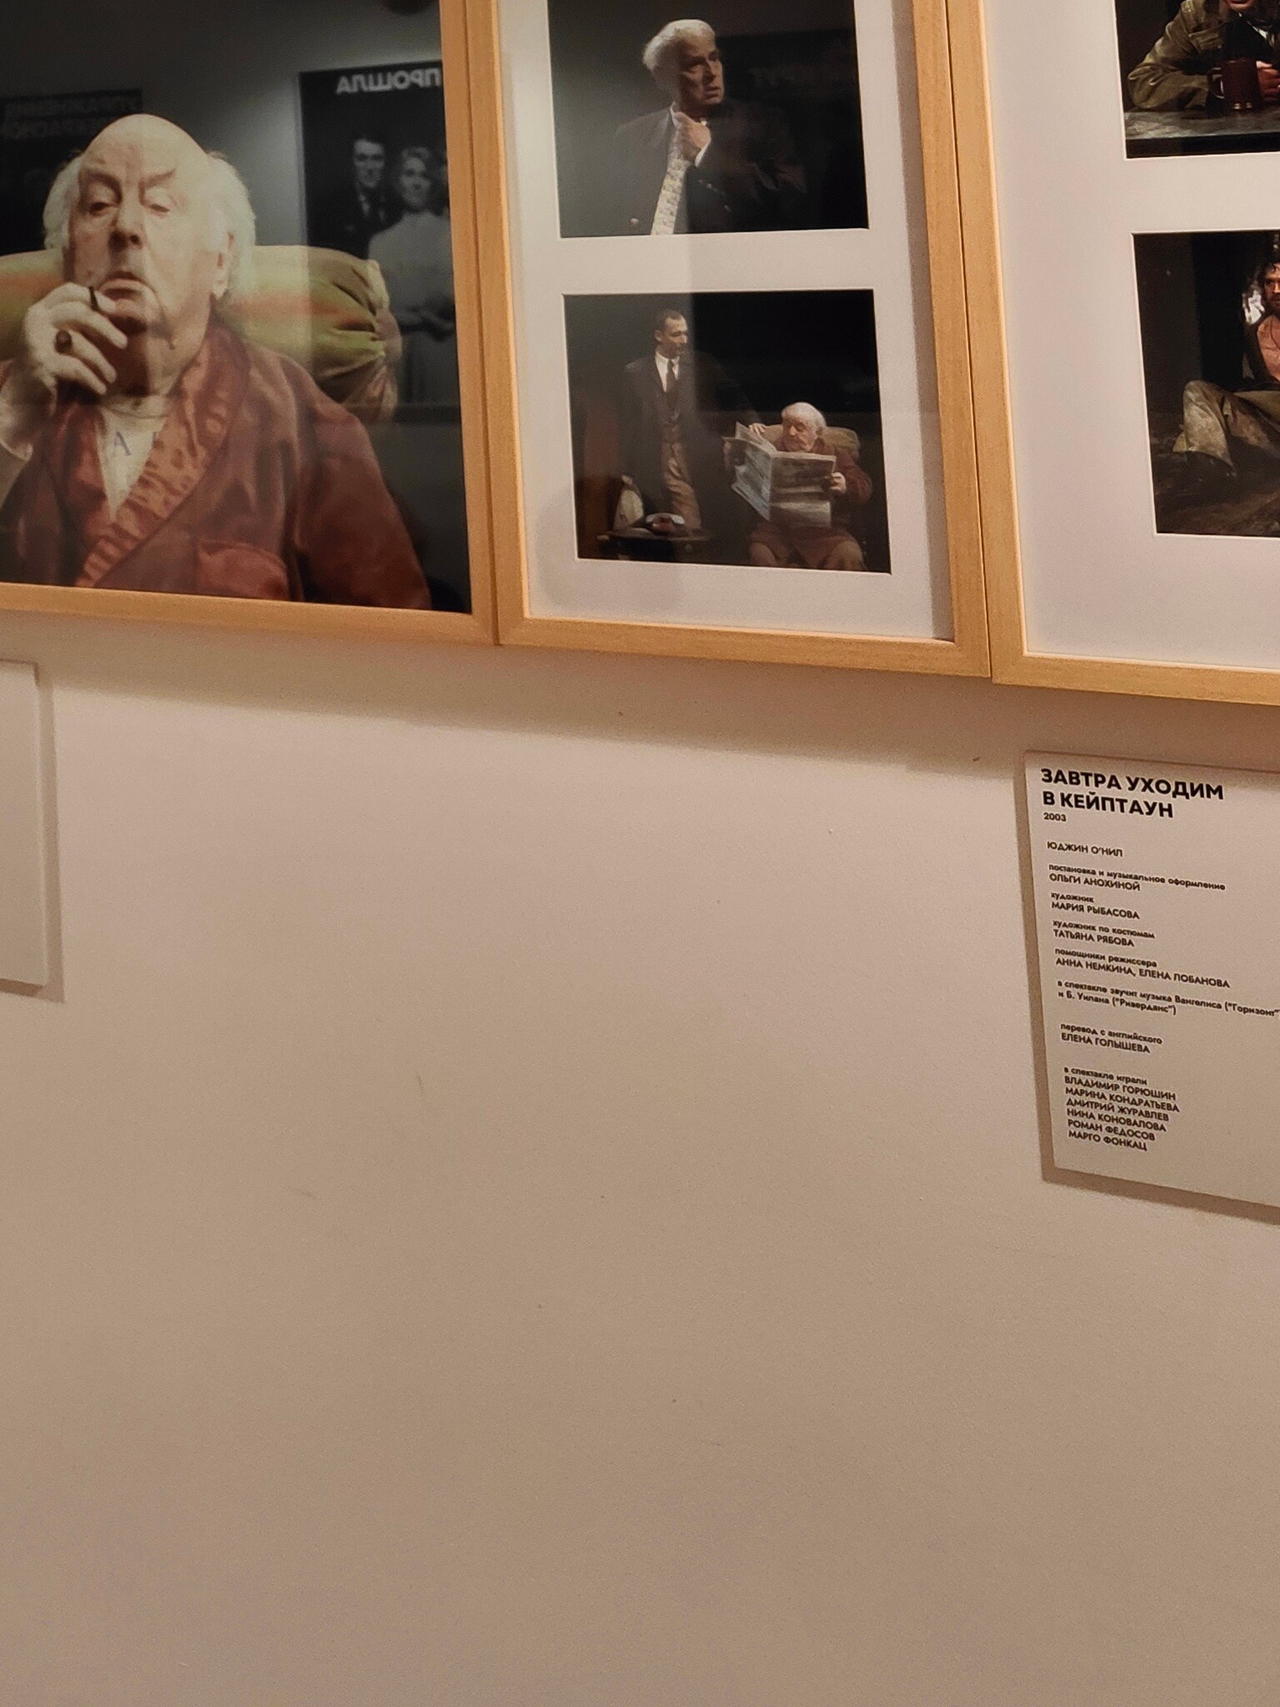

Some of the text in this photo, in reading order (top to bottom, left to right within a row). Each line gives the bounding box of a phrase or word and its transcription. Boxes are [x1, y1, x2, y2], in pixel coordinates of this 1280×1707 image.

[1040, 768, 1224, 800] ЗАВТРА УХОДИМ
[1042, 790, 1173, 818] В КЕЙПТАУН
[1043, 812, 1066, 822] 2003
[1047, 841, 1088, 853] ЮДЖИН
[1049, 864, 1096, 875] постановка
[1107, 871, 1165, 883] музыкальное
[1168, 878, 1225, 890] оформление
[1049, 873, 1140, 891] ОЛЬГИ АНОХИНОЙ
[1051, 892, 1094, 903] художник
[1051, 901, 1140, 920] МАРИЯ РЫБАСОВА
[1052, 920, 1096, 931] художник
[1112, 928, 1155, 939] костюмам
[1053, 929, 1135, 947] ТАТЬЯНА РЯБОВА
[1054, 948, 1157, 968] помощники режиссера
[1055, 957, 1231, 988] АННА НЕМКИНА, ЕЛЕНА ЛОБАНОВА
[1064, 981, 1108, 993] спектакле
[1110, 987, 1138, 997] звучит
[1139, 992, 1172, 1003] музыка
[1174, 994, 1222, 1010] Вангелиса
[1077, 992, 1110, 1004] Уилана
[1060, 1023, 1098, 1035] перевод
[1108, 1032, 1162, 1045] английского
[1061, 1032, 1150, 1054] ЕЛЕНА ГОЛЫШЕВА
[1071, 1067, 1114, 1080] спектакле
[1116, 1075, 1148, 1085] играли
[1064, 1075, 1176, 1101] ВЛАДИМИР ГОРЮШИН
[1065, 1087, 1180, 1113] МАРИНА КОНДРАТЬЕВА
[1066, 1097, 1170, 1122] ДМИТРИЙ ЖУРАВЛЕВ
[1066, 1108, 1167, 1132] НИНА КОНОВАЛОВА
[1067, 1119, 1156, 1141] РОМАН ФЕДОСОВ
[1068, 1130, 1148, 1152] МАРГО ФОНКАЦ
